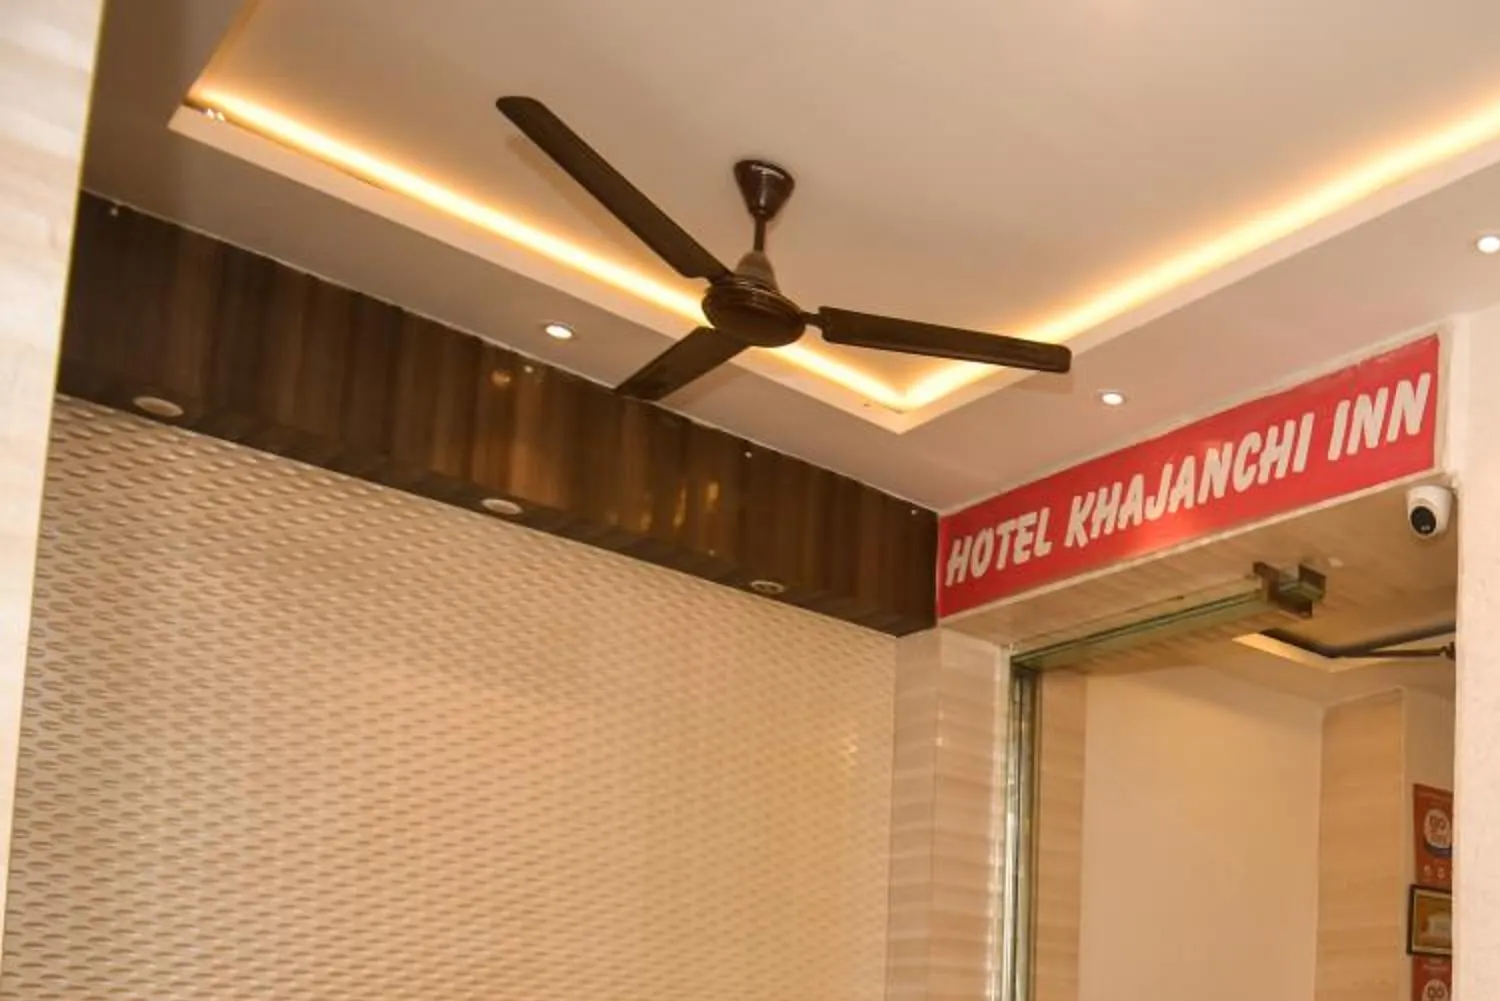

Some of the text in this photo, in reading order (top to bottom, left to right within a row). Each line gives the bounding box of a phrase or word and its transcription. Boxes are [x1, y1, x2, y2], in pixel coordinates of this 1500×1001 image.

[945, 373, 1431, 587] HOTEL KHAJANCHI INN
